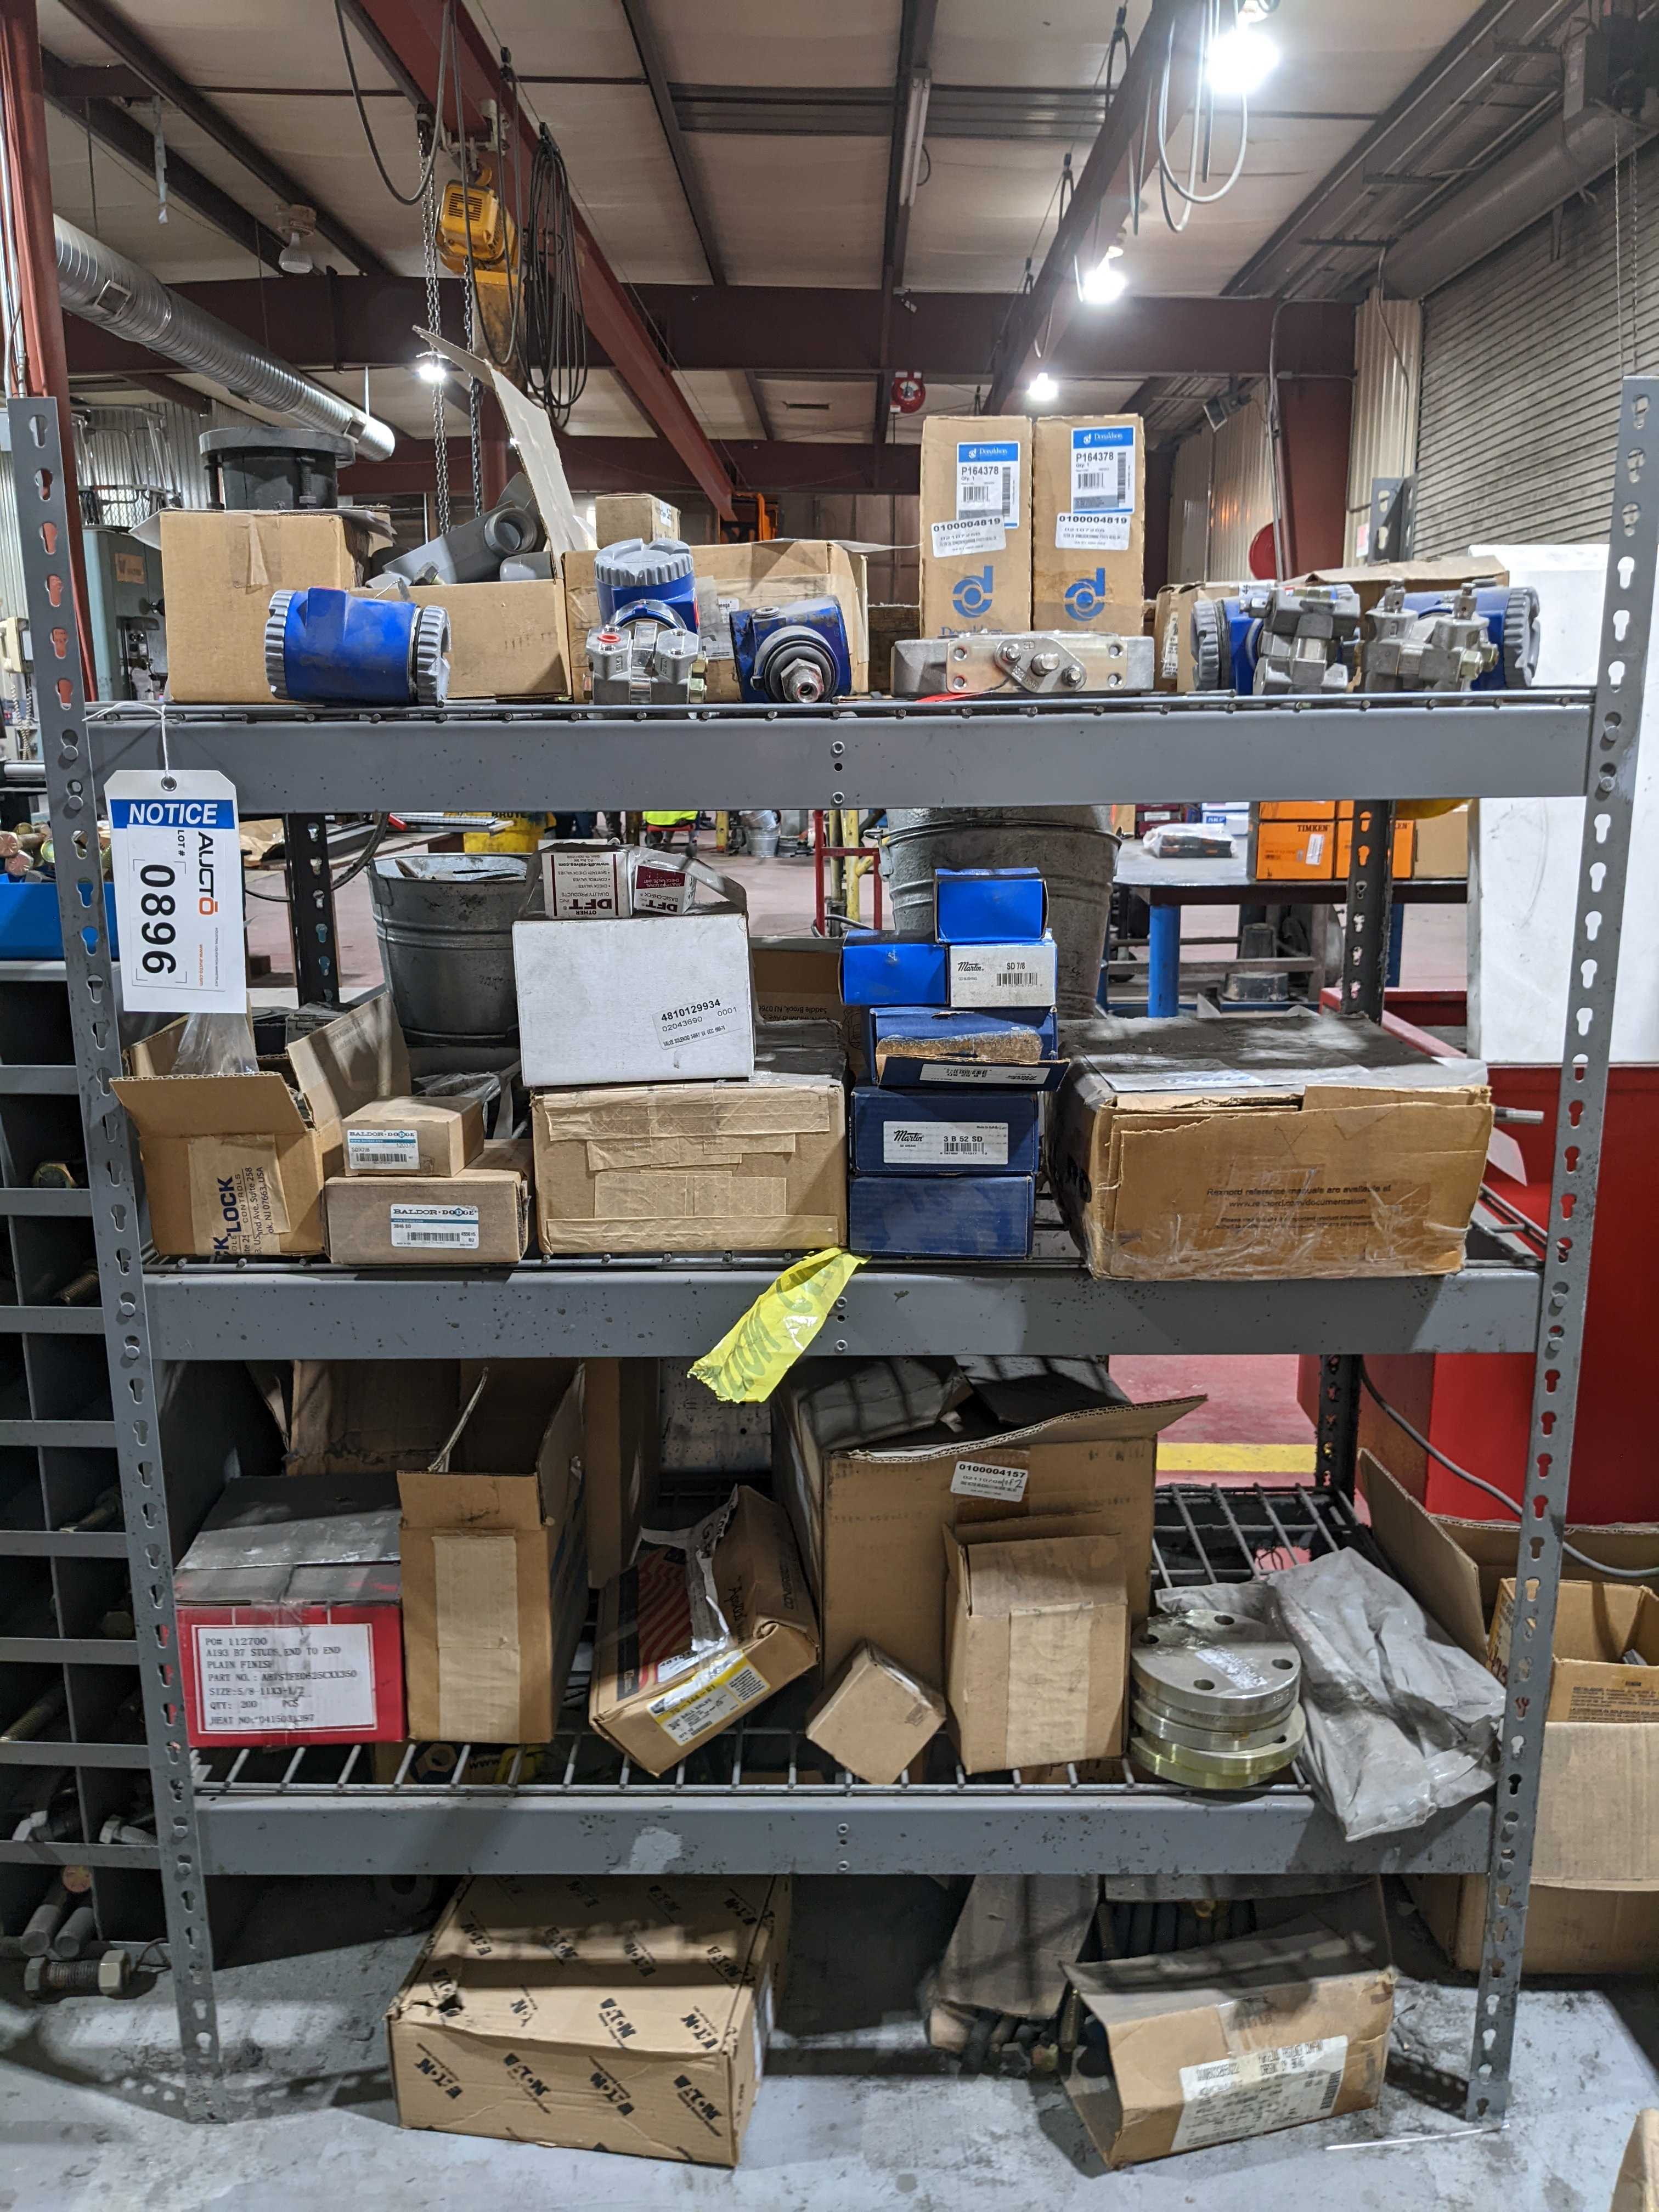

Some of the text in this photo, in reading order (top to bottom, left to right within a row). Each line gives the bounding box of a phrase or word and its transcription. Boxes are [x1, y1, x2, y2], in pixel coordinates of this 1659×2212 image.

[1076, 452, 1114, 462] P164378
[962, 466, 998, 475] P164378
[934, 518, 1000, 532] 0100004819
[1059, 516, 1127, 524] 0100004819
[129, 803, 218, 825] NOTICE
[645, 893, 678, 902] BASIC-CHECK
[569, 899, 612, 910] DFT
[645, 900, 678, 912] DFT
[140, 864, 177, 974] 0896
[957, 961, 982, 972] Martin
[662, 998, 721, 1022] 4810129934
[662, 1006, 737, 1032] 02043690 0001
[674, 1035, 690, 1043] SOLENOID
[894, 1130, 923, 1142] Martin
[245, 1167, 254, 1181] 258
[235, 1173, 249, 1223] CONTROLS
[249, 1183, 258, 1202] Suite
[217, 1176, 242, 1234] LOCK
[265, 1211, 272, 1220] NJ
[960, 1464, 1025, 1478] 0100004157
[229, 1637, 268, 1646] 112700
[207, 1661, 236, 1669] PLAIN
[282, 1699, 299, 1707] PCS
[211, 1717, 235, 1725] HEAT
